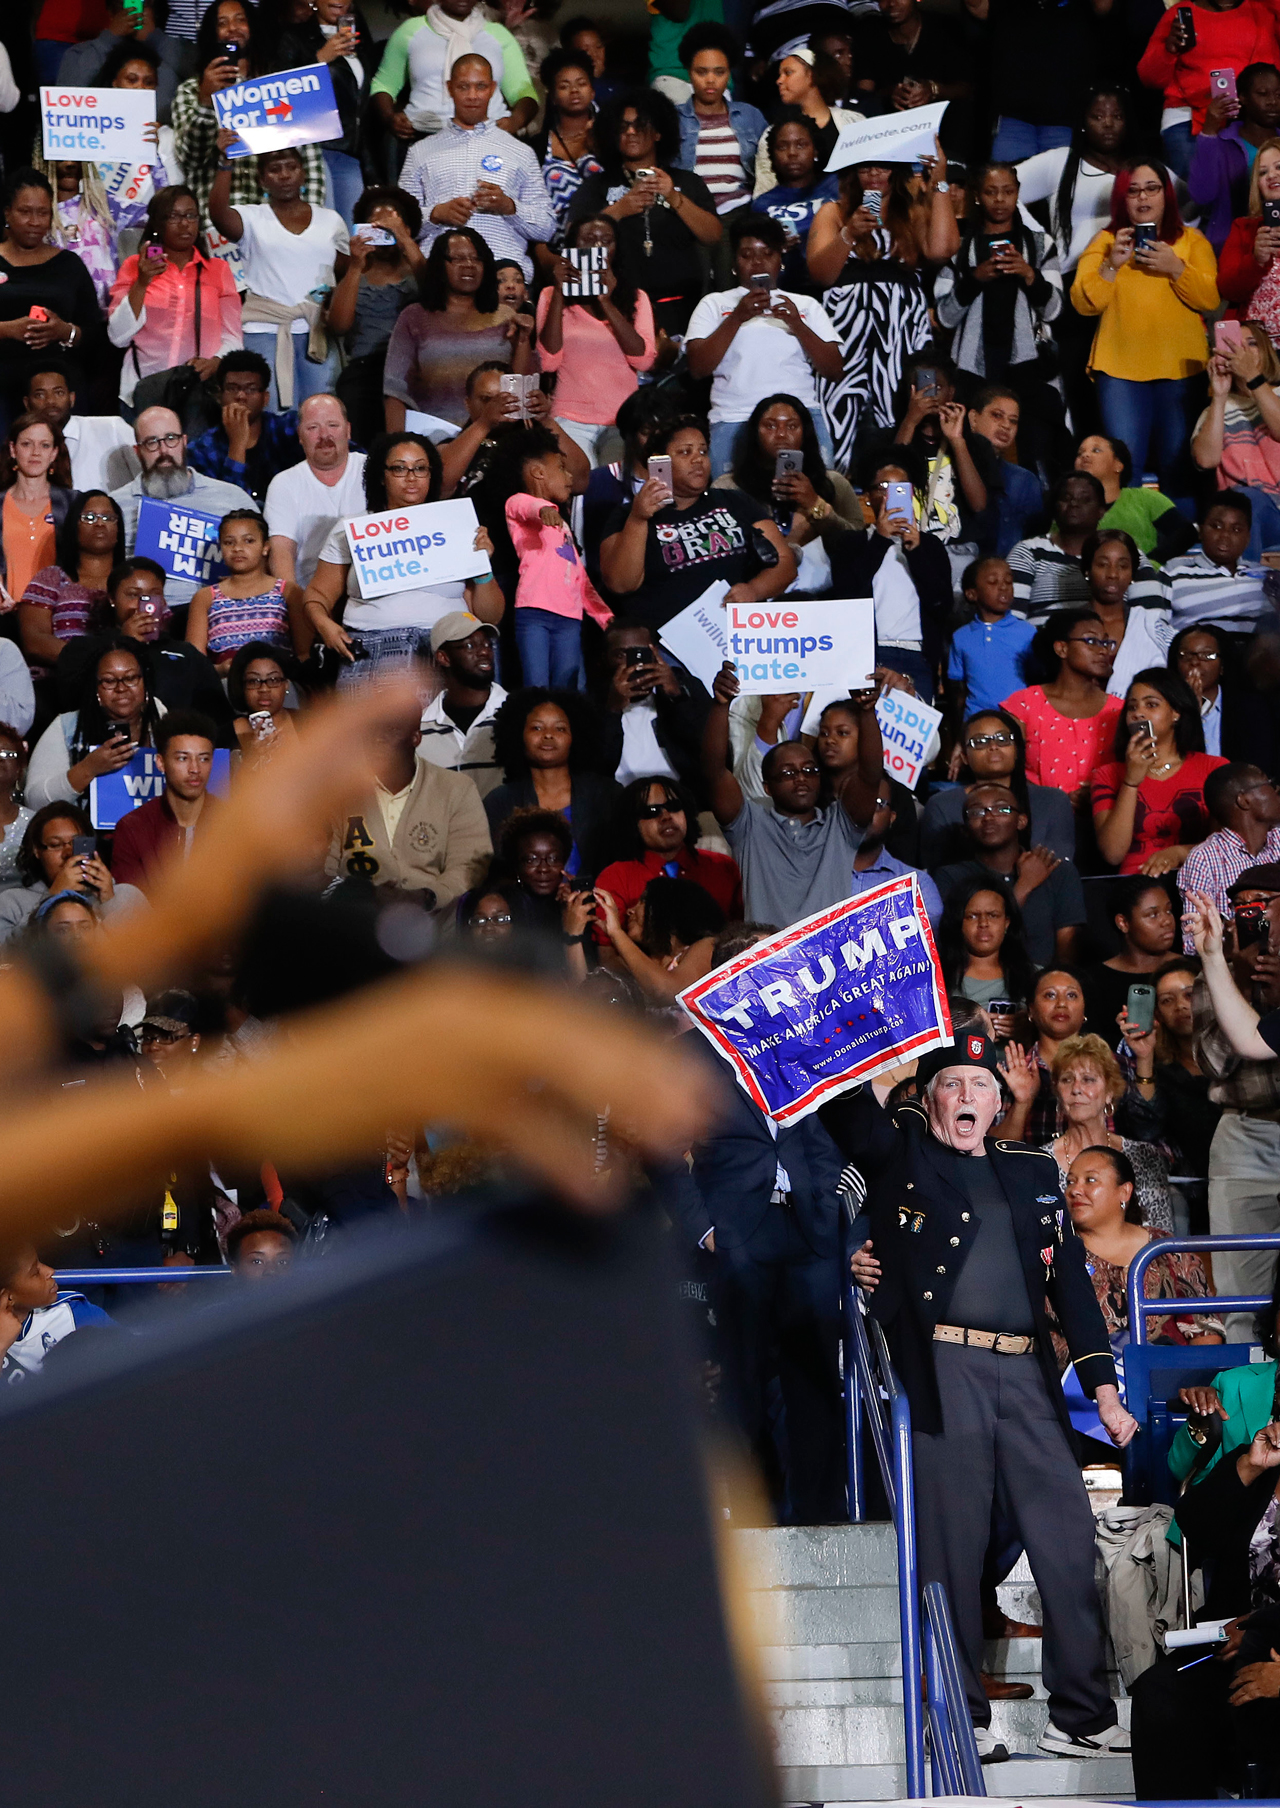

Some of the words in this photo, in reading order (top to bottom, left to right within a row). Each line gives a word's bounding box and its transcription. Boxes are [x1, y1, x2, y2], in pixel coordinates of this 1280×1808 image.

[45, 91, 97, 108] Love
[217, 74, 320, 111] Women
[45, 110, 125, 133] trumps
[222, 110, 261, 129] for
[48, 129, 106, 149] hate.
[840, 122, 932, 150] iwillvote.com
[125, 164, 150, 199] ove
[349, 517, 410, 540] Love
[158, 530, 222, 563] WITH
[354, 532, 446, 562] trumps
[662, 527, 746, 566] GRAD
[173, 554, 211, 580] I'M
[360, 559, 429, 585] hate.
[732, 608, 799, 629] Love
[730, 633, 833, 658] trumps
[734, 657, 807, 681] hate.
[883, 749, 916, 784] Lov
[723, 915, 919, 1030] TRUMP
[748, 1034, 783, 1059] MAKE
[785, 998, 841, 1040] AMERICA
[842, 974, 886, 1003] GREAT
[888, 960, 930, 983] AGAIN!
